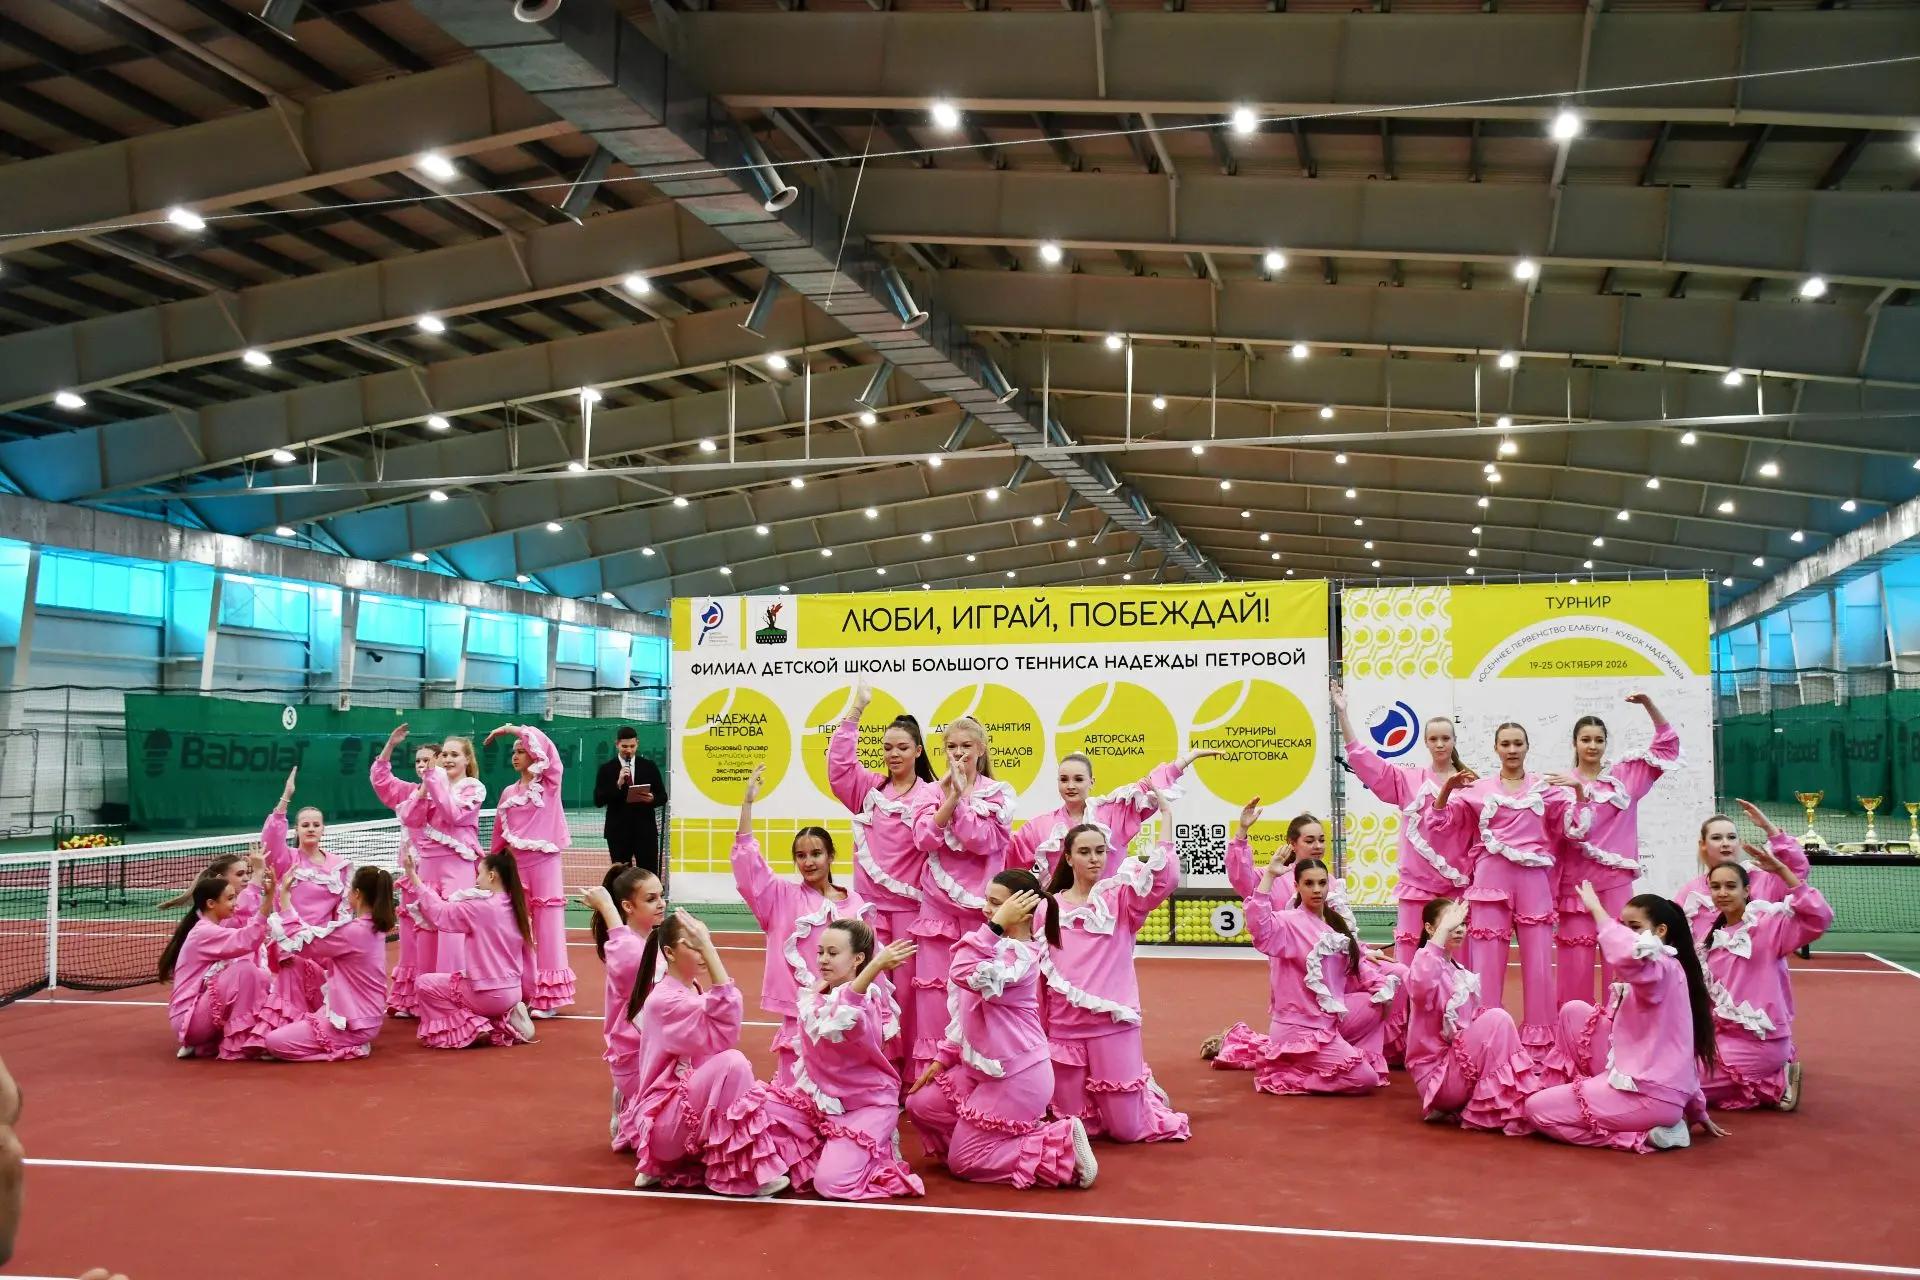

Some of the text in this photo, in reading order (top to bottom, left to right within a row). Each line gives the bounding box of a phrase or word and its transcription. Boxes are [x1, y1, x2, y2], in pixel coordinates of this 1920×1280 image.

[1545, 595, 1611, 609] ТУРНИР
[842, 591, 1270, 635] ЛЮБИ, ИГРАЙ, ПОБЕЖДАЙ!
[1511, 625, 1567, 651] ПЕРВЕНСТВО
[1568, 624, 1609, 633] ЕЛАБУГИ
[1615, 629, 1645, 647] КУБОК
[691, 648, 1306, 676] ФИЛИАЛ ДЕТСКОЙ ШКОЛЫ БОЛЬШОГО ТЕННИСА НАДЕЖДЫ ПЕТРОВОЙ
[1529, 660, 1628, 669] 19-25 ОКТЯБРЯ 2026
[706, 713, 768, 725] НАДЕЖДА
[709, 726, 764, 737] ПЕТРОВА
[1225, 727, 1277, 736] ТУРНИРЫ
[1084, 734, 1145, 743] АВТОРСКАЯ
[1191, 738, 1312, 748] И ПСИХОЛОГИЧЕСКАЯ
[1085, 746, 1145, 756] МЕТОДИКА
[1214, 751, 1289, 762] ПОДГОТОВКА
[1220, 911, 1235, 931] 3
